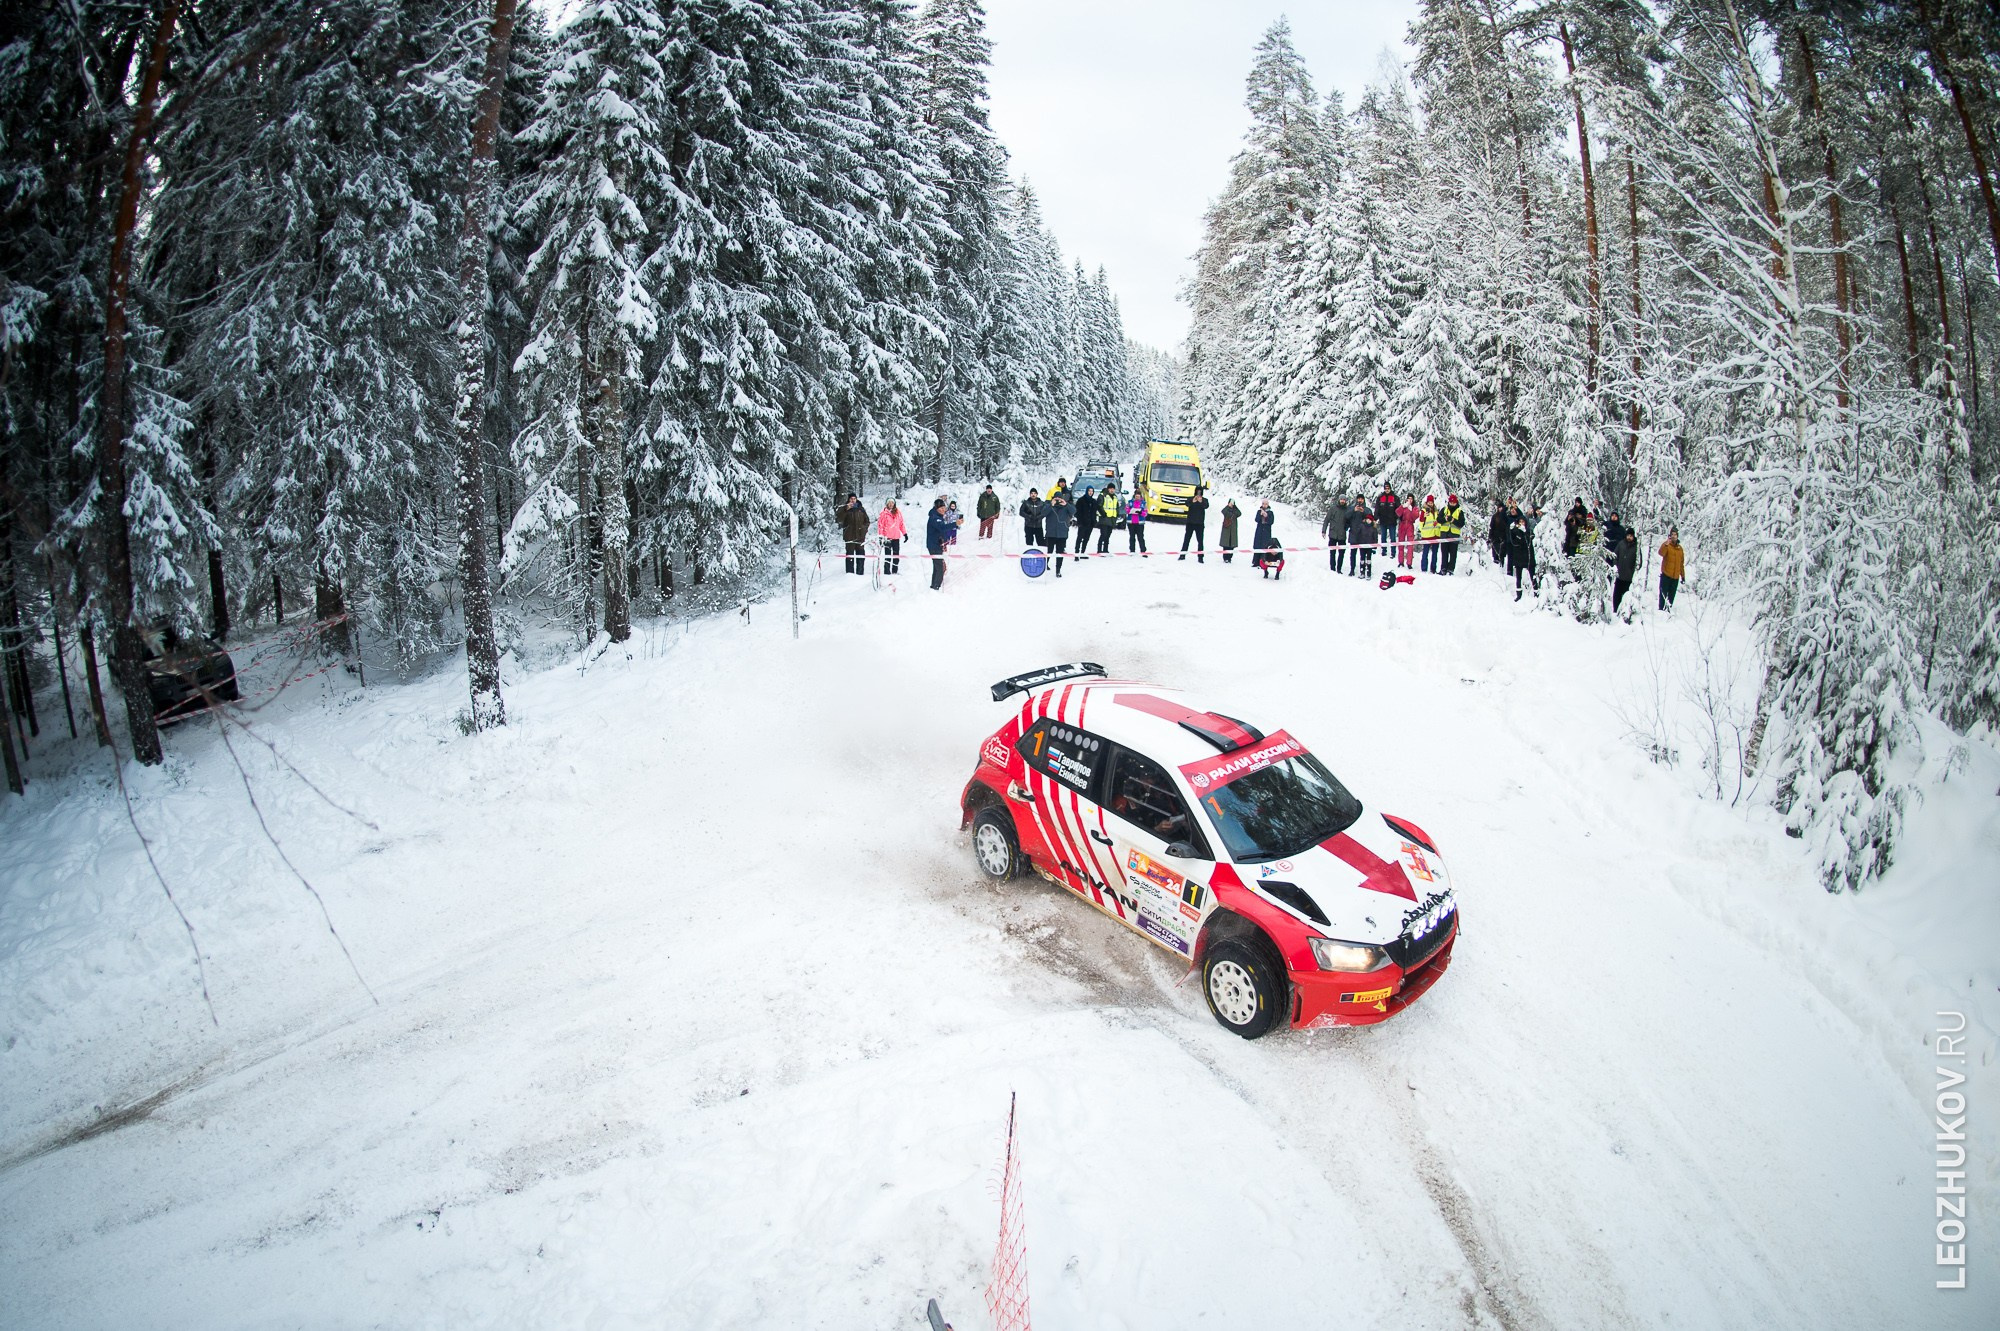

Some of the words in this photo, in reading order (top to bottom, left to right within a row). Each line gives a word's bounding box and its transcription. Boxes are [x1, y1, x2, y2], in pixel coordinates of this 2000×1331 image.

[1033, 730, 1045, 757] 1
[1057, 751, 1092, 778] Гаврилов
[1208, 756, 1252, 780] РАЛЛИ
[1250, 743, 1292, 763] РОССИИ
[1058, 766, 1088, 790] Еникеев
[1207, 796, 1224, 816] 1
[1165, 878, 1181, 896] 24
[1190, 884, 1199, 906] 1
